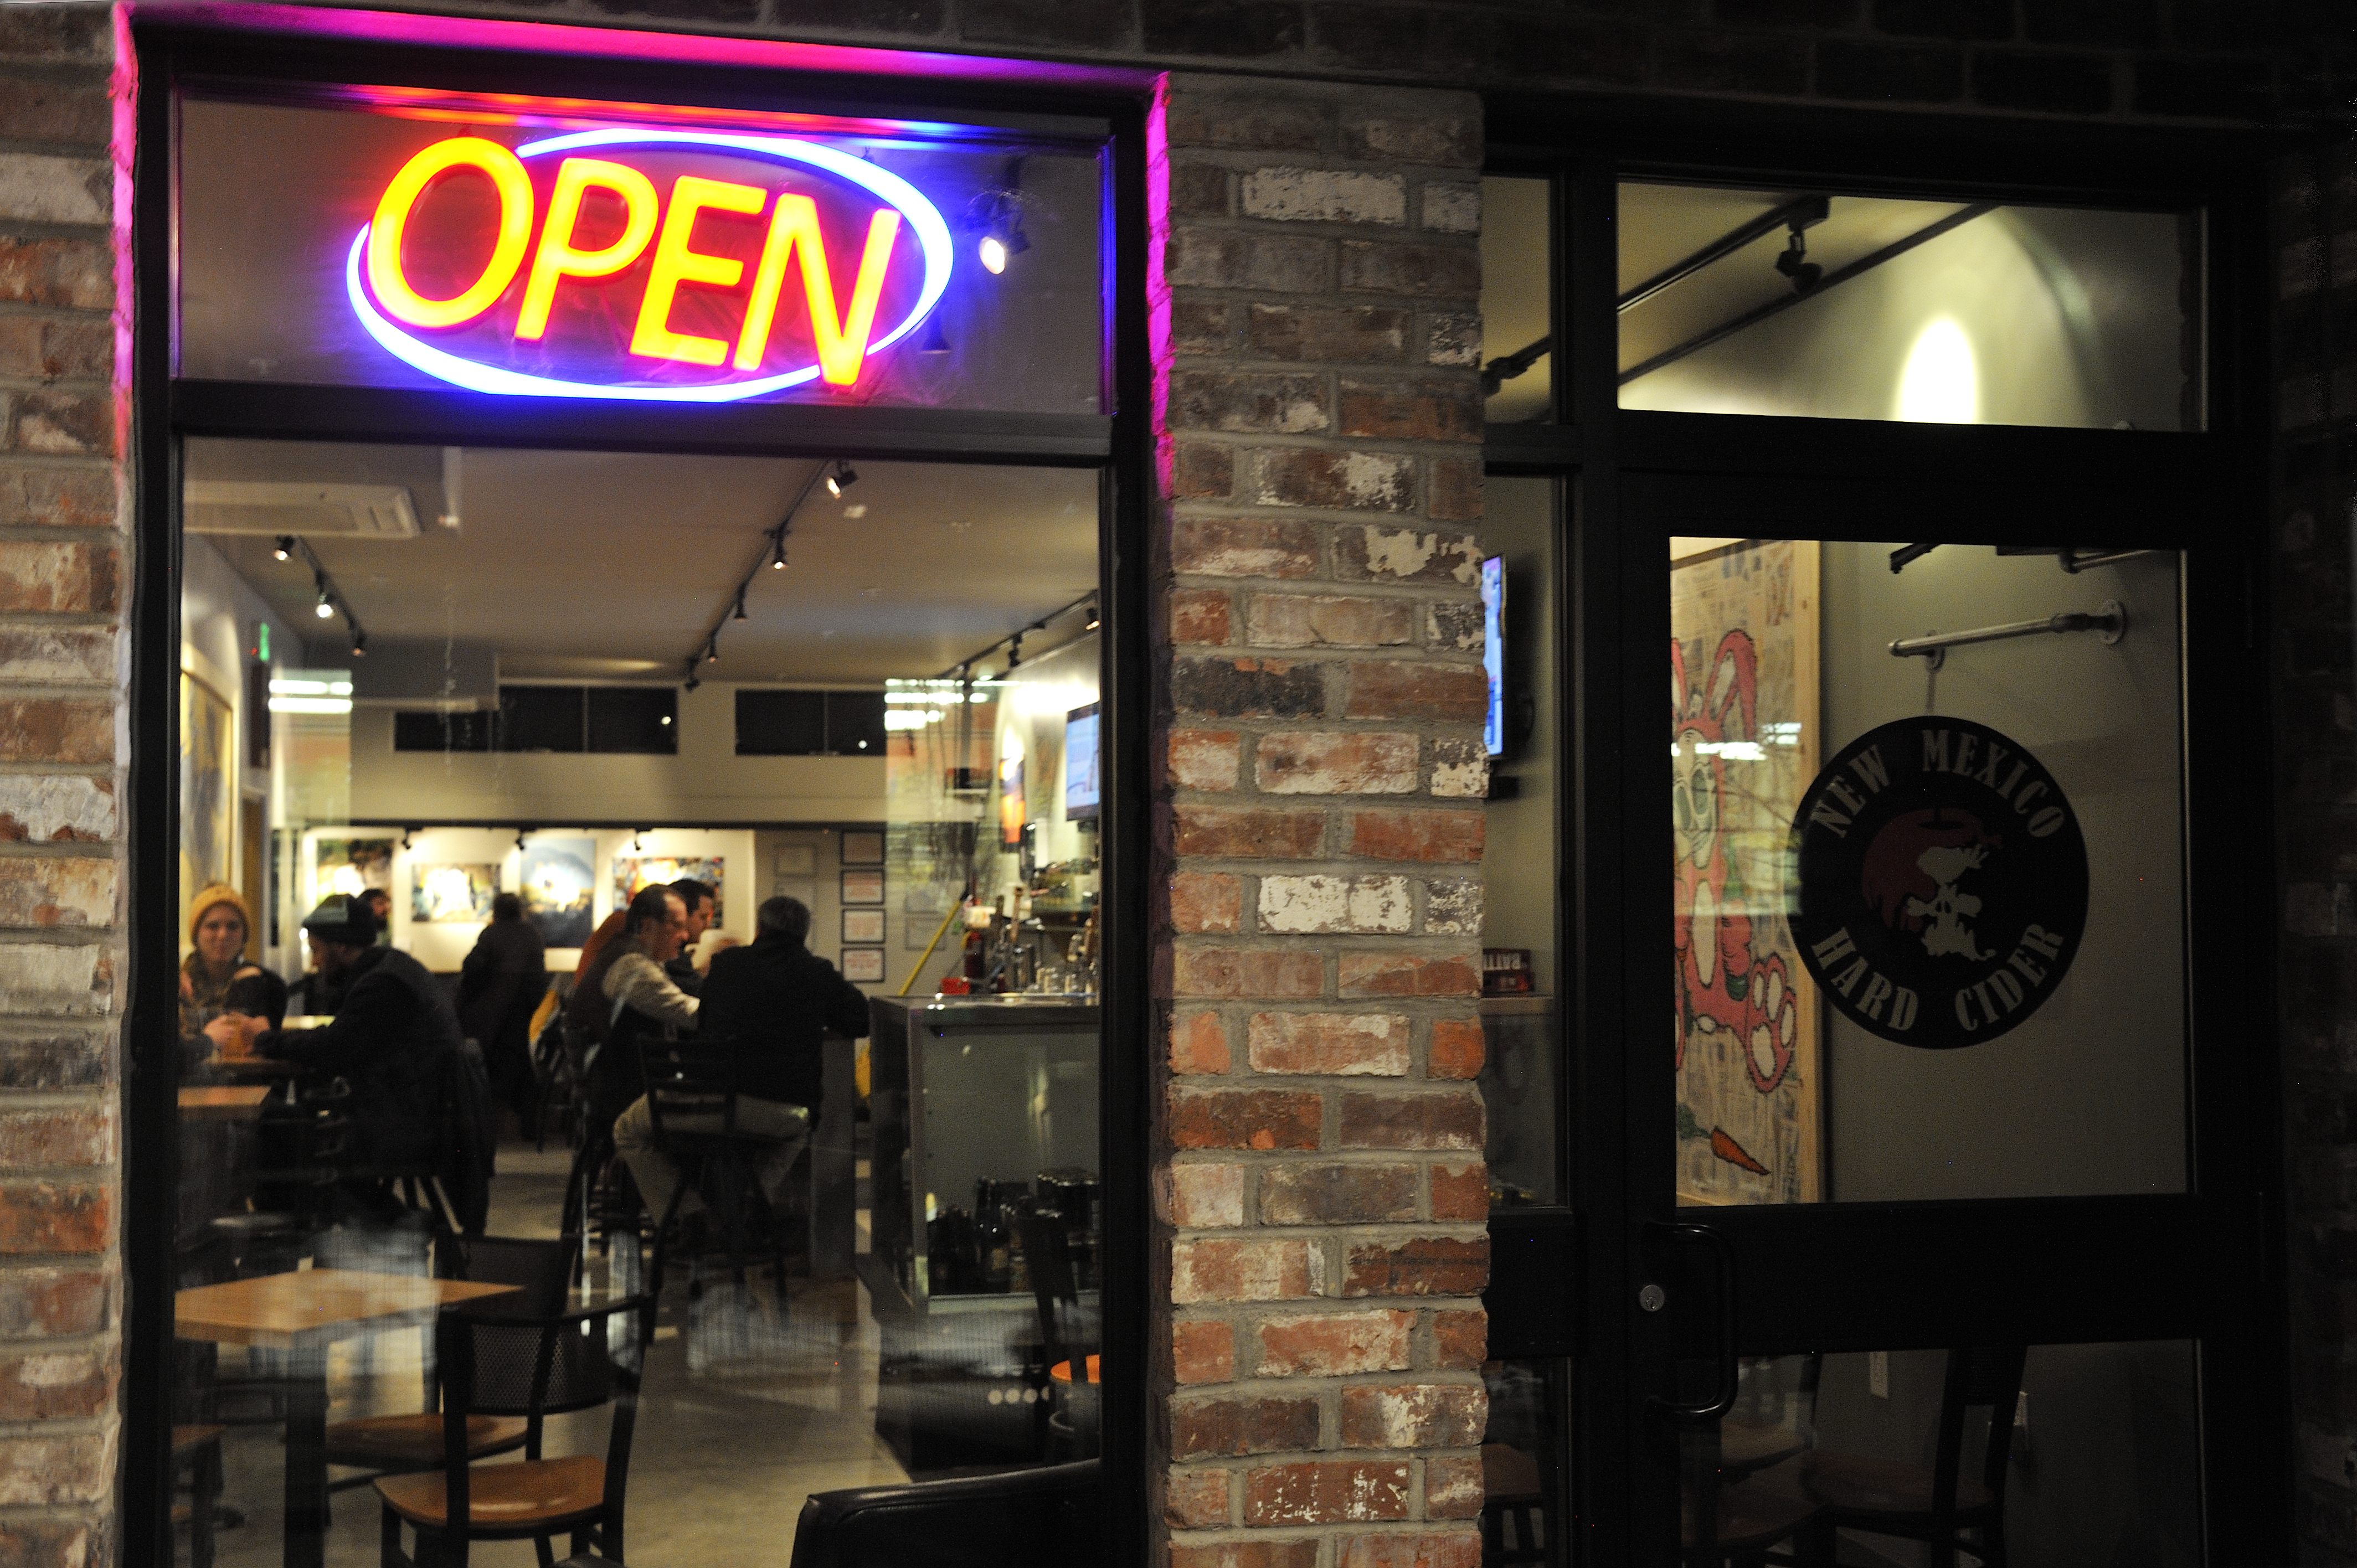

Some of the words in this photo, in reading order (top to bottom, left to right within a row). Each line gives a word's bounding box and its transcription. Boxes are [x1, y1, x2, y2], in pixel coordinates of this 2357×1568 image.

[368, 136, 901, 386] OPEN
[1810, 744, 1890, 838] NEW
[1922, 729, 2065, 838] MEXICO
[1810, 927, 1919, 1031] HARD
[1954, 924, 2064, 1031] CIDER
